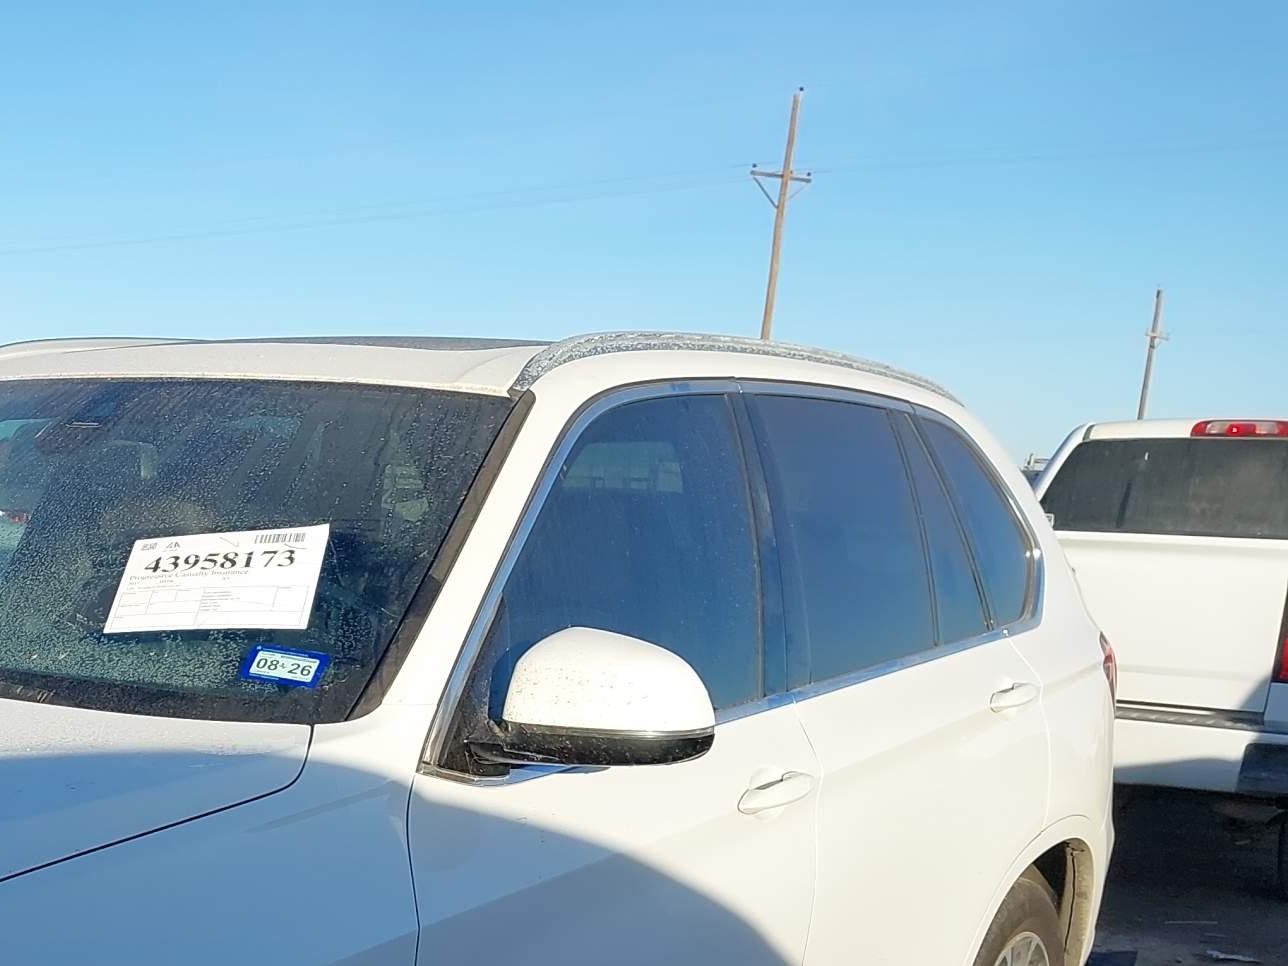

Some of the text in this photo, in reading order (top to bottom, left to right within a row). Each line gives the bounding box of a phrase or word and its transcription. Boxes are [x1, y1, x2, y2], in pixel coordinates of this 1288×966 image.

[144, 549, 296, 573] 43958173
[256, 658, 280, 671] 08
[288, 663, 312, 677] 26
